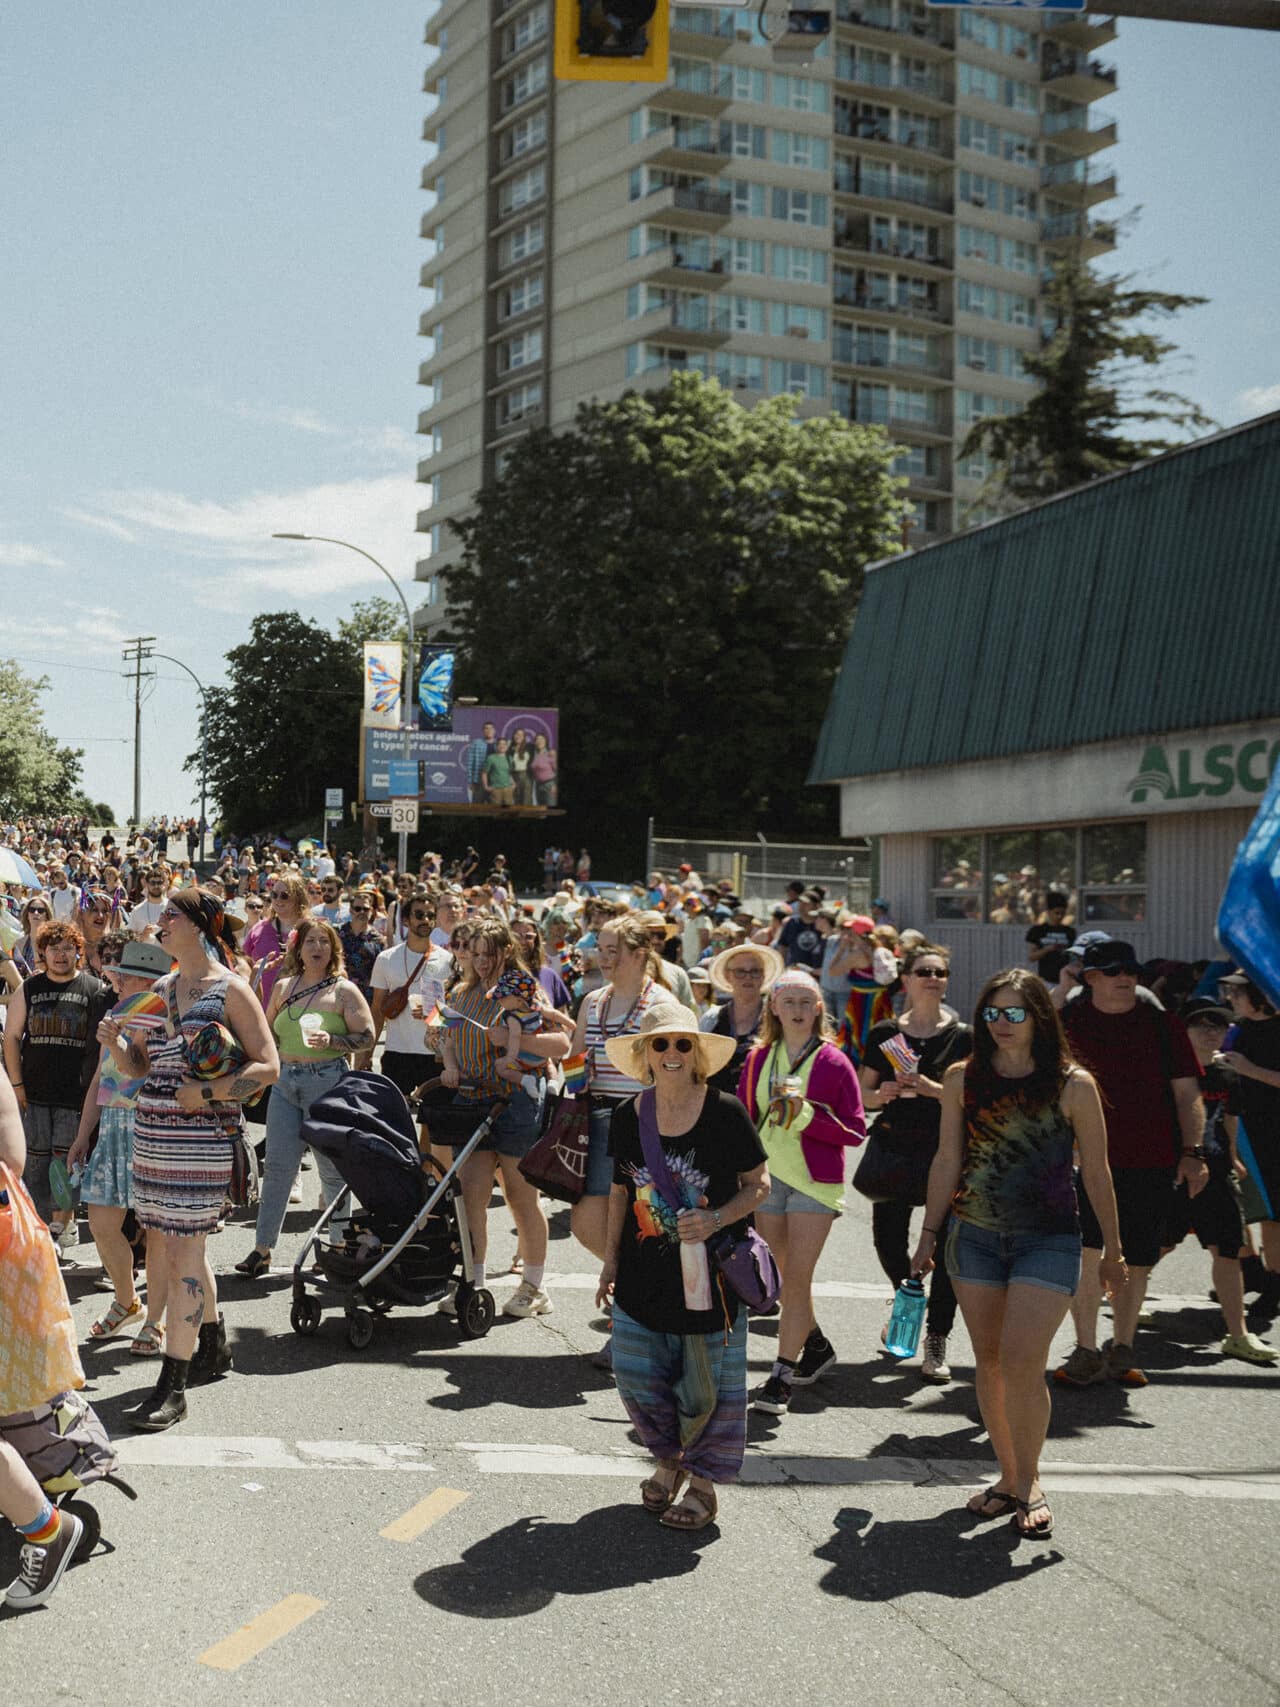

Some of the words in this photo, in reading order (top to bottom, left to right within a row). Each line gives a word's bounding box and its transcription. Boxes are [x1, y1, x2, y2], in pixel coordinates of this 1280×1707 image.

[373, 730, 398, 741] helps
[400, 732, 433, 742] potect
[435, 733, 470, 743] against
[419, 744, 453, 752] cancer.
[1127, 740, 1280, 803] ALSC
[394, 808, 416, 823] 30
[31, 992, 88, 1007] CALIFORNIA
